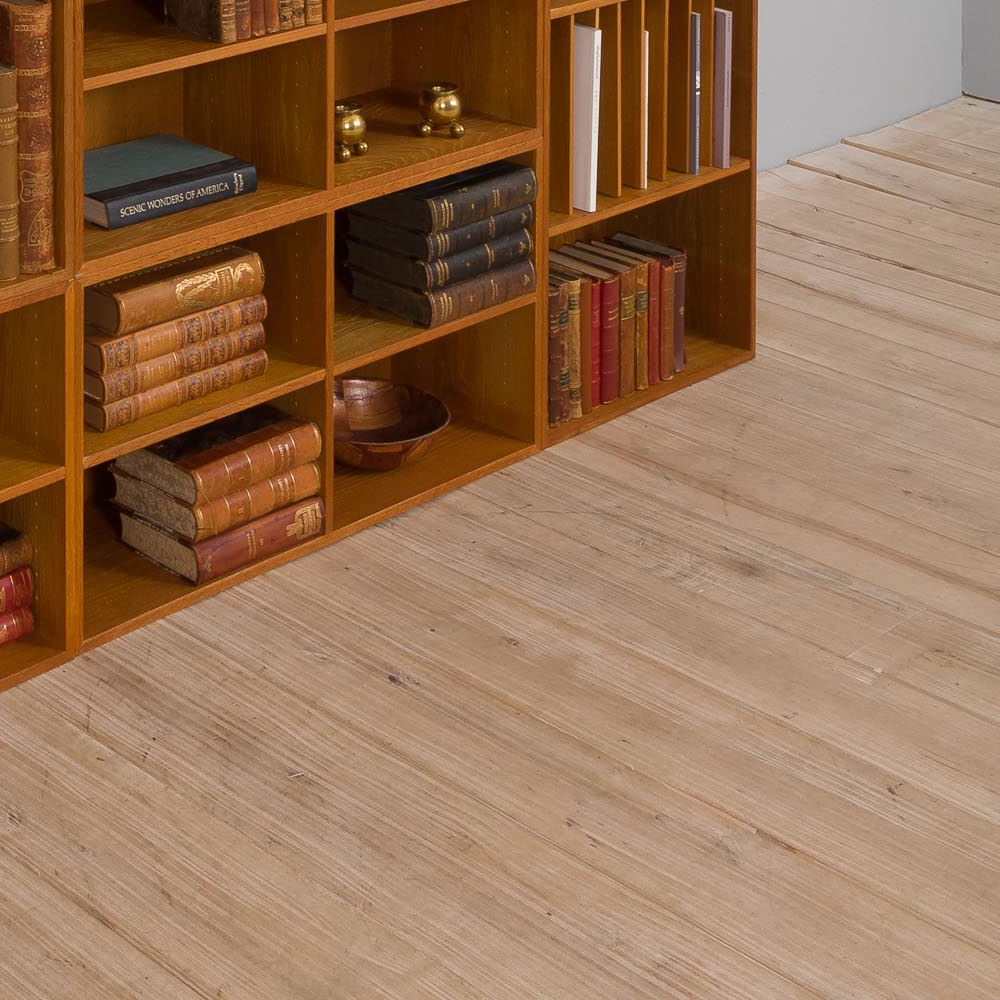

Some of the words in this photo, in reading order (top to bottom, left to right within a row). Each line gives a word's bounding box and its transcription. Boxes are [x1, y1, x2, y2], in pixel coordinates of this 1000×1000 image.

[119, 202, 146, 218] SCENIC
[146, 193, 184, 209] WONDERS
[185, 190, 196, 200] OF
[196, 181, 230, 199] AMERICA
